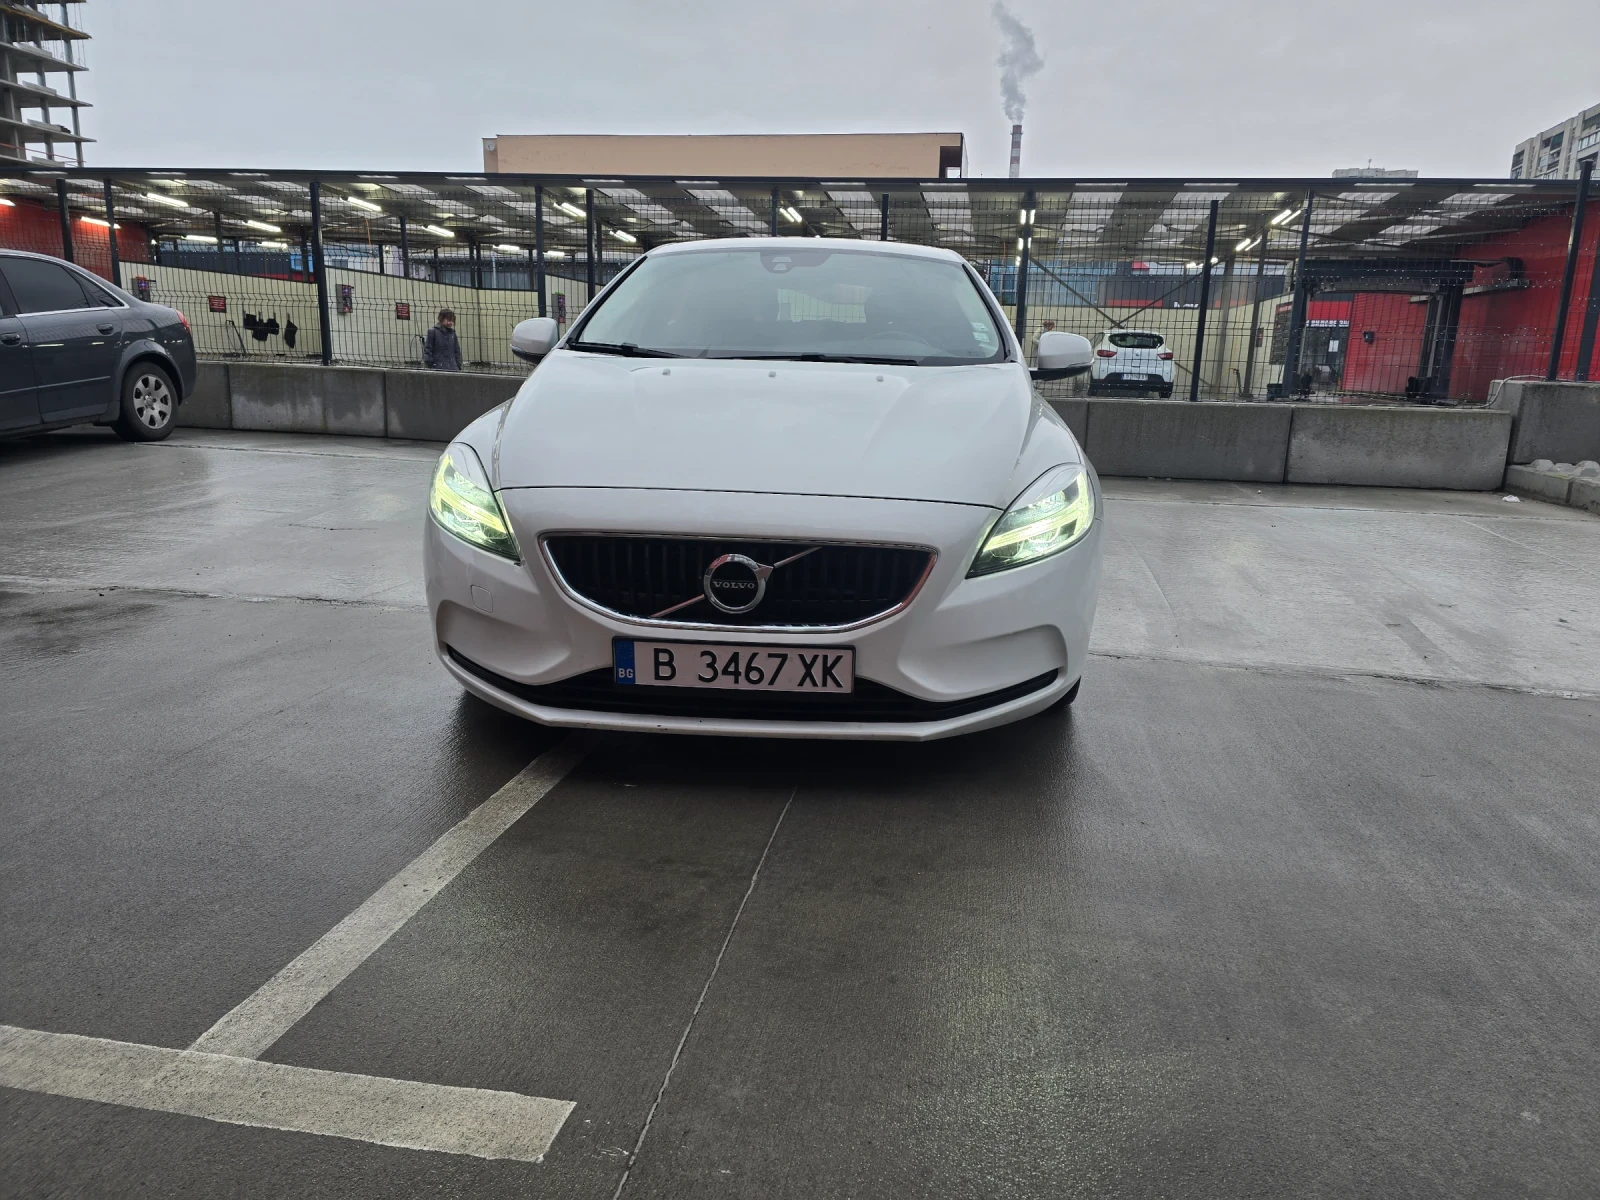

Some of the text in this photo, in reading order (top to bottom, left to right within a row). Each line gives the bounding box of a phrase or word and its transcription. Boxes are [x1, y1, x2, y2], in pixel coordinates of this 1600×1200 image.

[712, 581, 755, 589] VOLVO
[618, 667, 634, 679] BG
[653, 647, 844, 688] B 3467 XK
